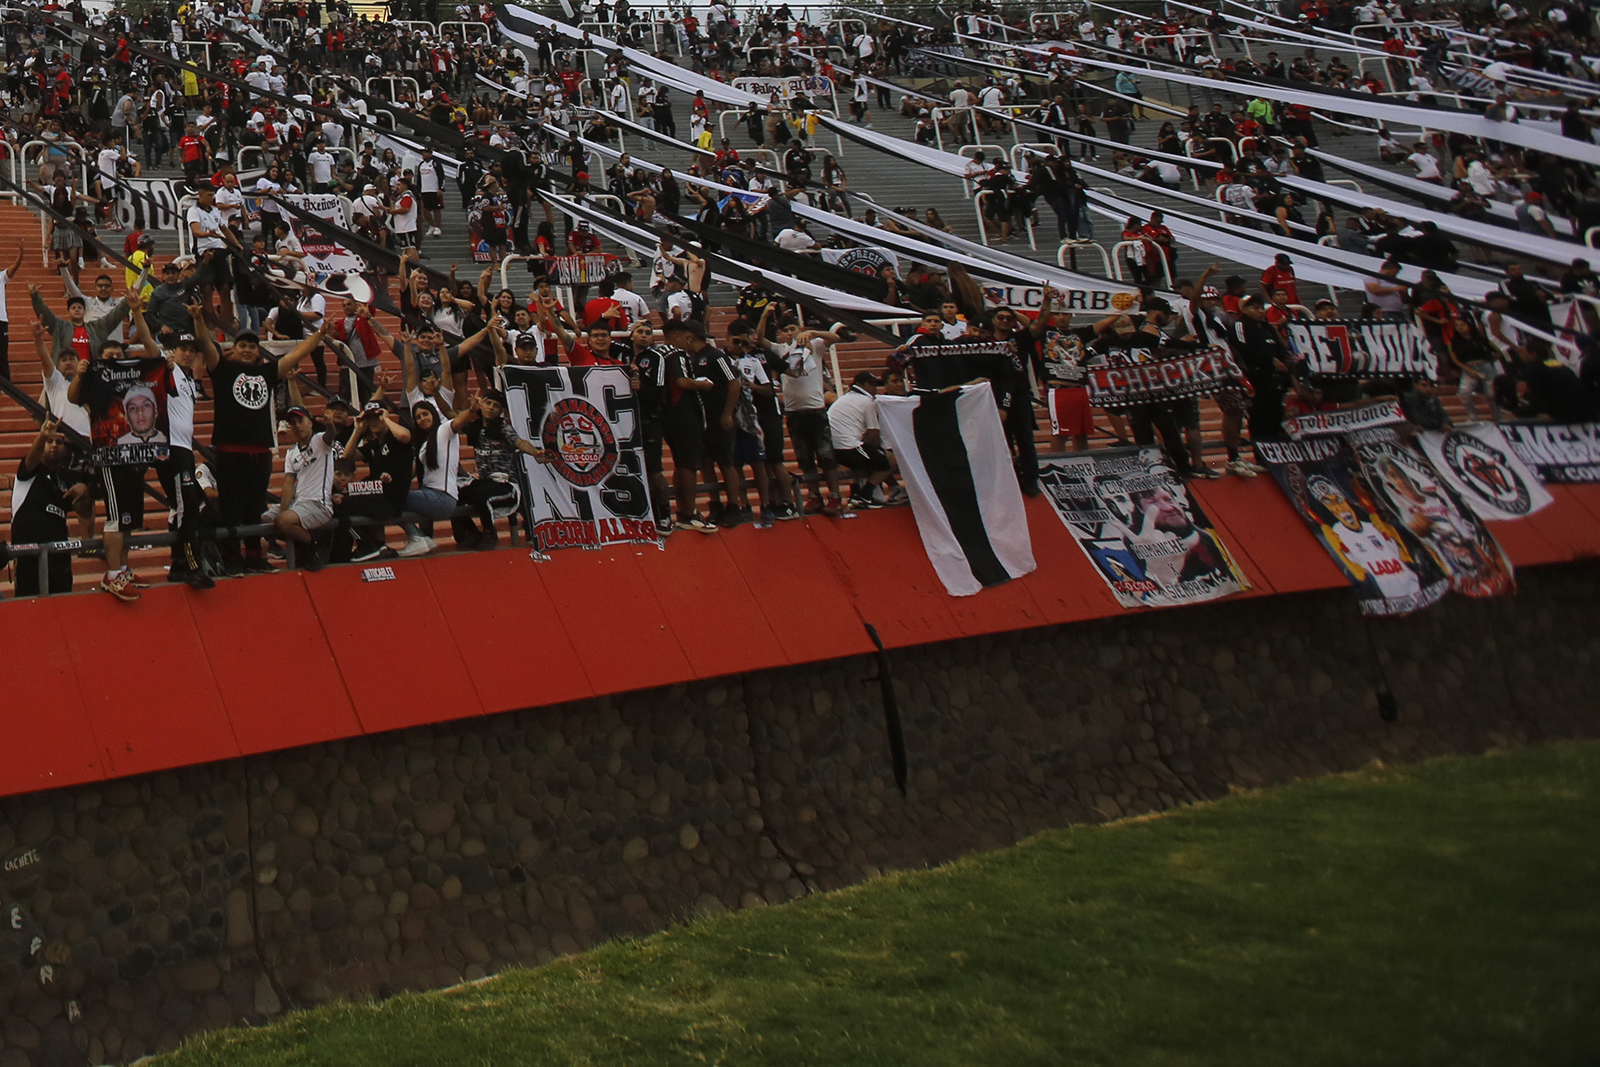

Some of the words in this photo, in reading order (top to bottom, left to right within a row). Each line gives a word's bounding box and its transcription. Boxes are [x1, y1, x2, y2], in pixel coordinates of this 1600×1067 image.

[101, 367, 142, 382] Chancho
[348, 479, 383, 493] INTOCABLES
[1367, 558, 1403, 576] LADA
